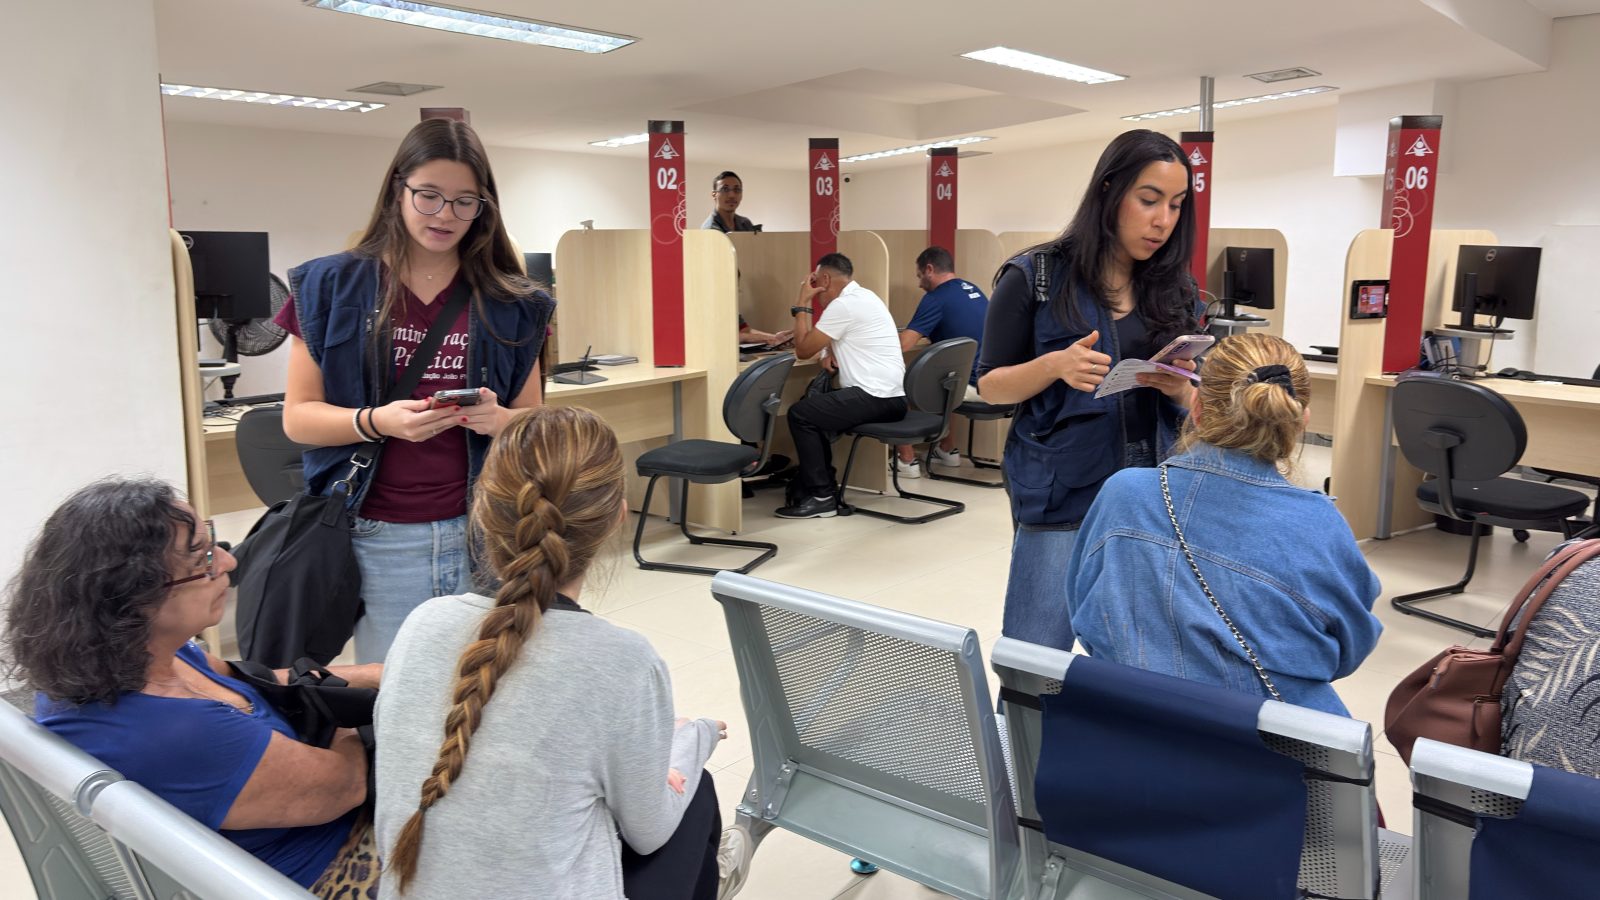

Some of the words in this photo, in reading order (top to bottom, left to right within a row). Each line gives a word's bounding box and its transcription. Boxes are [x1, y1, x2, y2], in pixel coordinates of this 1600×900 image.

[657, 167, 678, 190] 02
[816, 176, 833, 196] 03
[1192, 172, 1205, 193] 5
[1405, 166, 1429, 190] 06
[936, 183, 953, 201] 04
